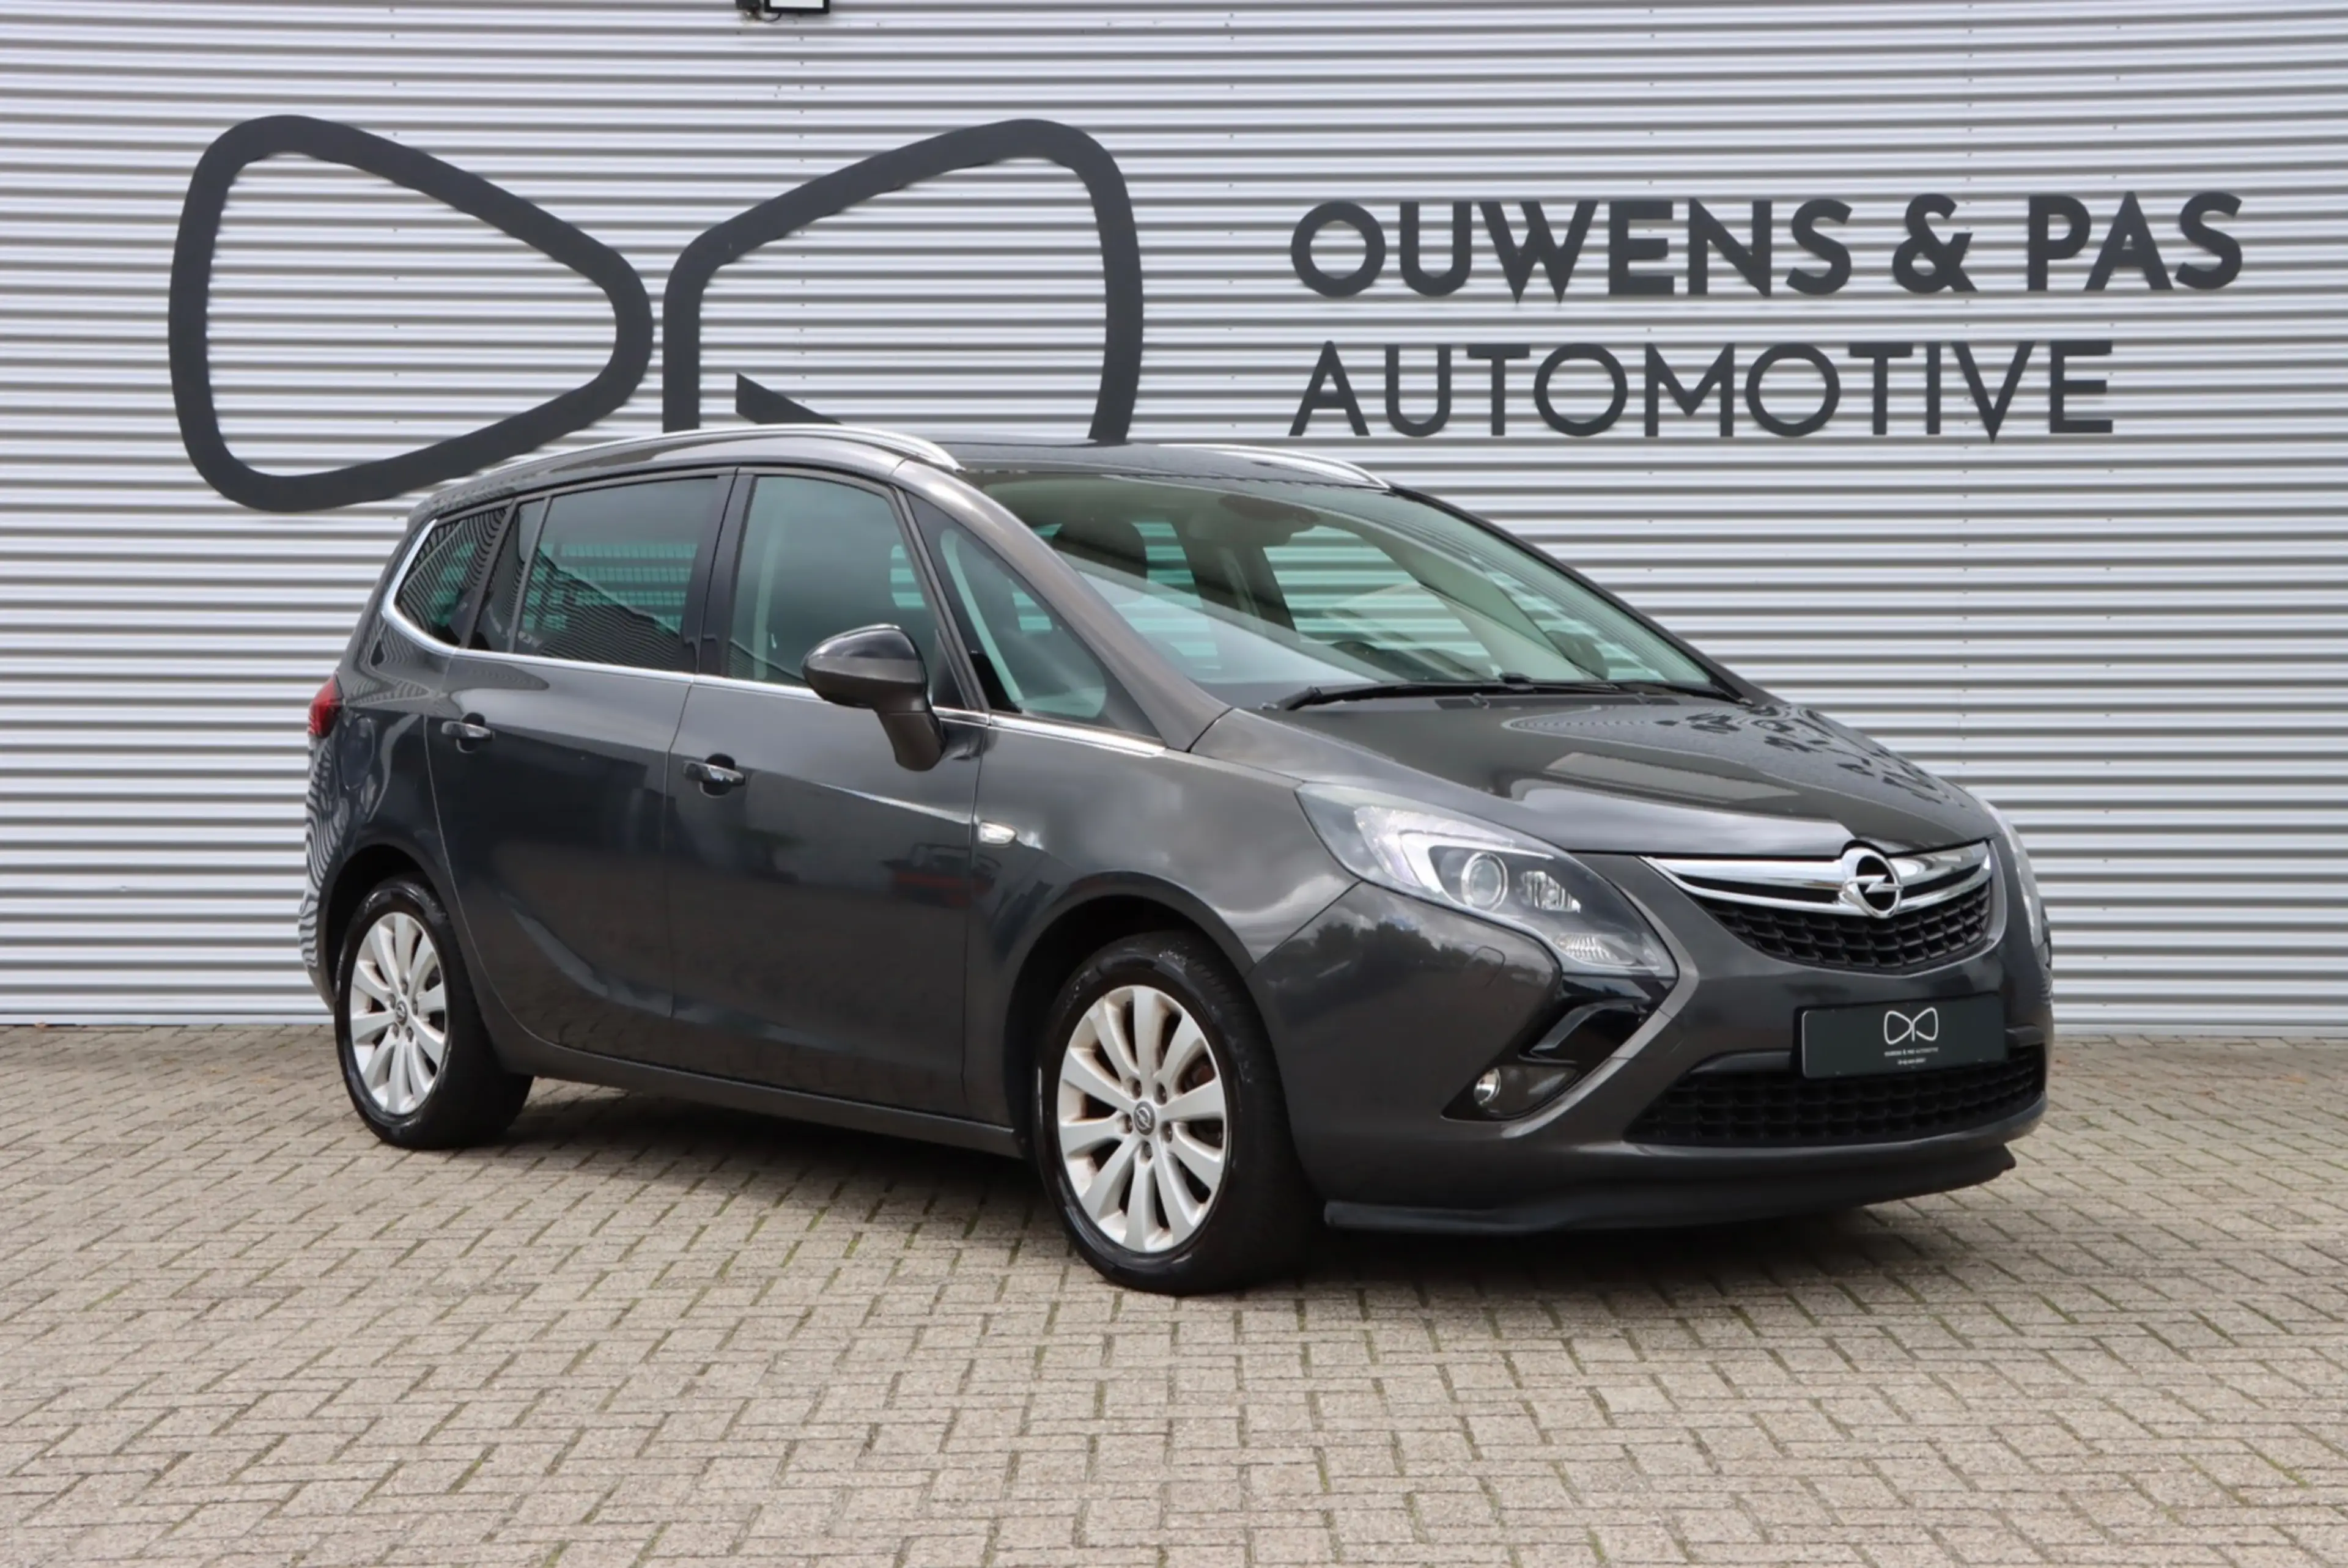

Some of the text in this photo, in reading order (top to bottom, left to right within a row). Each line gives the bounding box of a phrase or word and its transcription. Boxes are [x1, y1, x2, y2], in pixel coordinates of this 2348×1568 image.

[1290, 191, 2243, 302] OUWENS & PAS
[1290, 340, 2114, 441] AUTOMOTIVE
